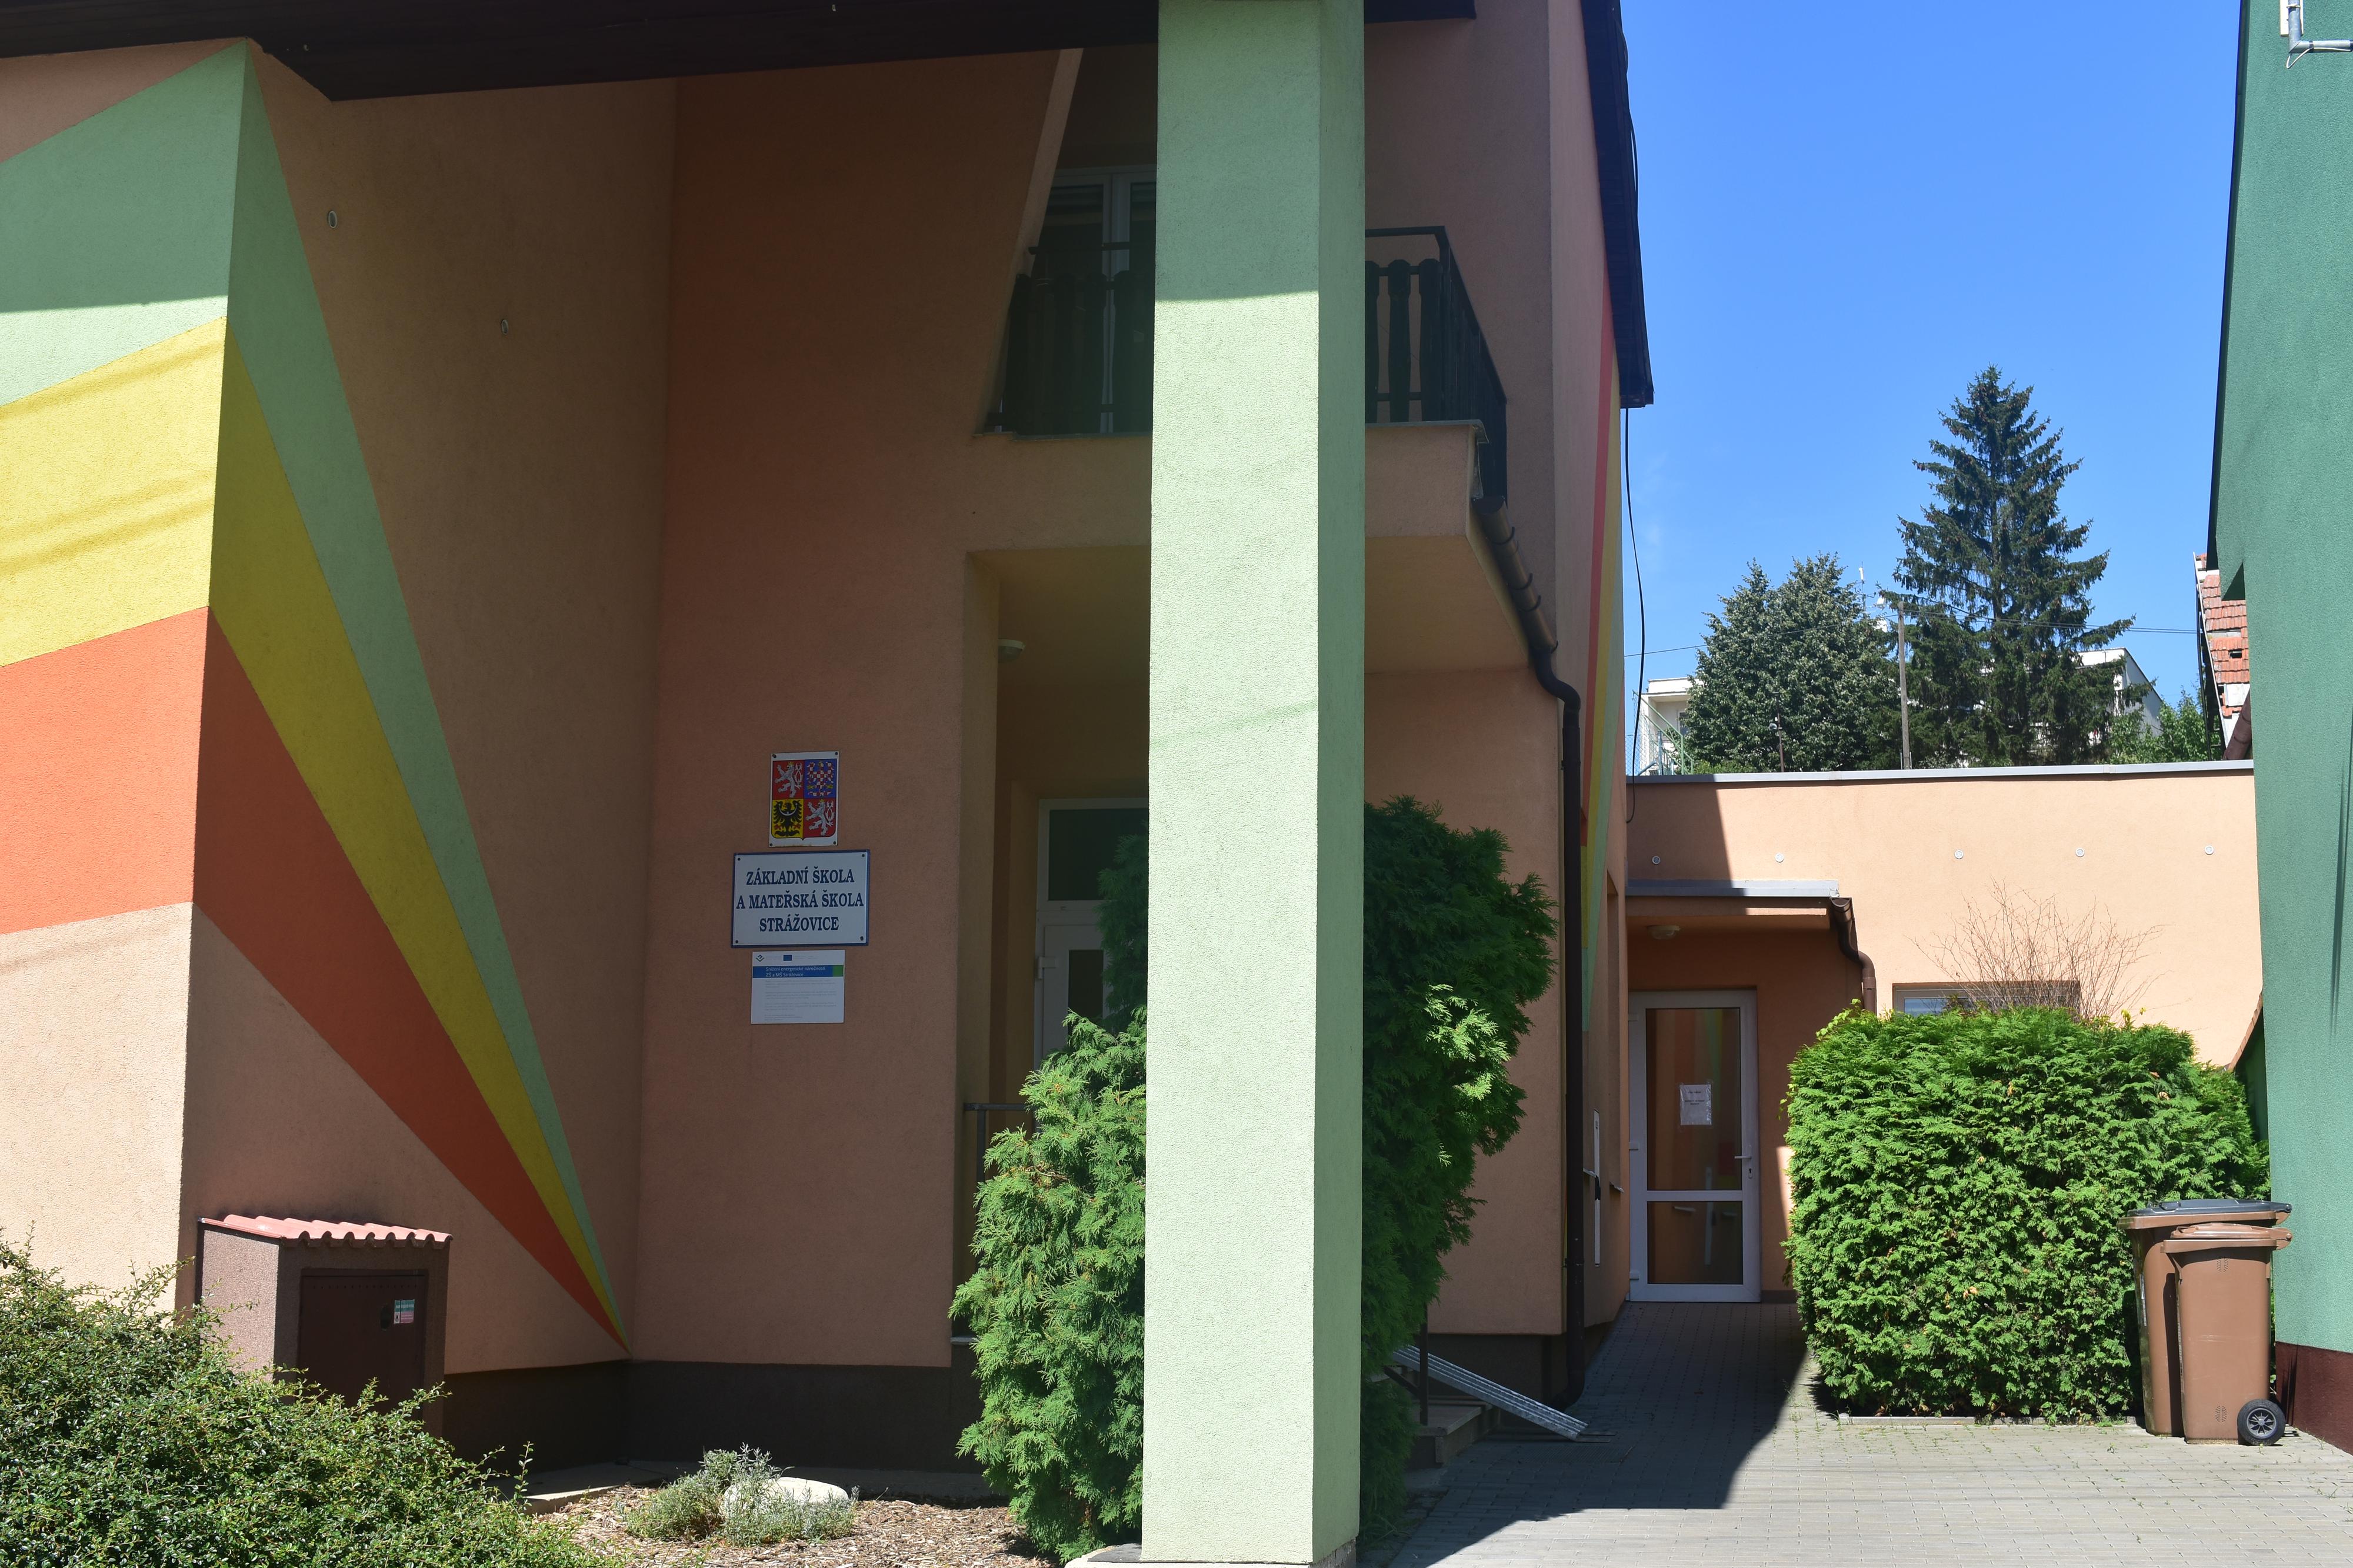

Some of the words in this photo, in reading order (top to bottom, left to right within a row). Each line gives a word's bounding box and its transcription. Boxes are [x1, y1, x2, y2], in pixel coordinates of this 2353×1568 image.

[746, 866, 808, 885] ZÁKLADNÍ
[812, 866, 855, 883] ŠKOLA
[736, 895, 745, 909] A
[749, 890, 818, 909] MATEŘSKÁ
[822, 889, 864, 907] ŠKOLA
[759, 913, 839, 932] STRÁŽOVICE
